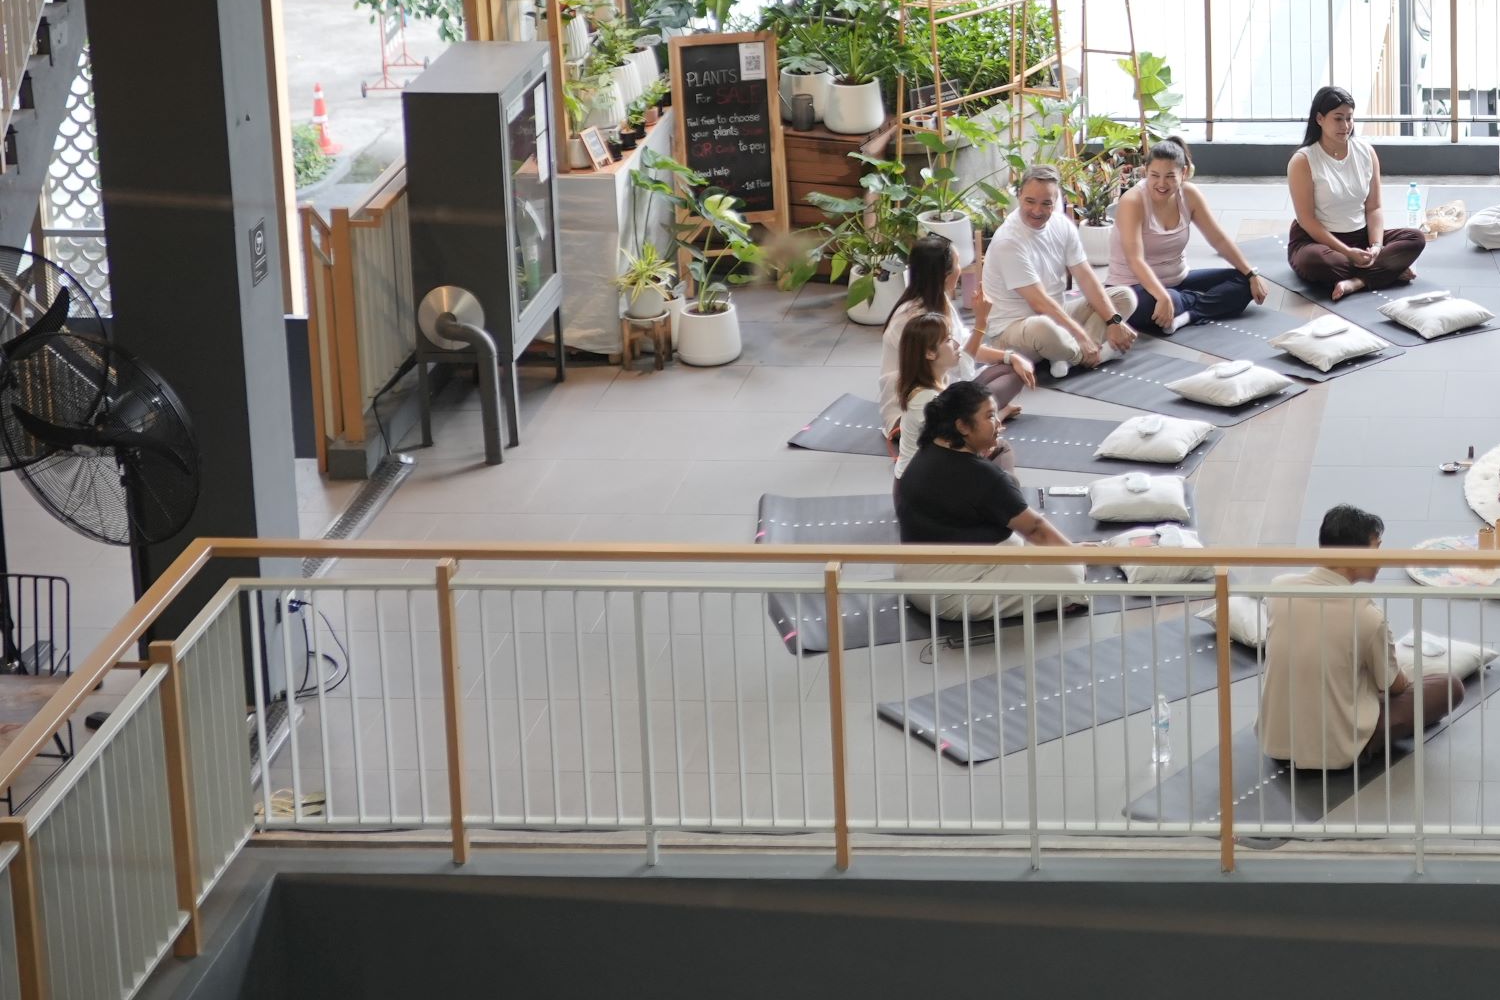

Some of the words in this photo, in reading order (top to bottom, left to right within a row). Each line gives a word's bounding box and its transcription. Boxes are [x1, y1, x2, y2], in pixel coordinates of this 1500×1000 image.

[686, 69, 738, 87] PLANTS
[695, 93, 711, 104] For
[701, 115, 716, 126] free
[717, 114, 726, 123] to
[728, 113, 760, 123] choose
[691, 130, 710, 141] your
[713, 125, 739, 139] plants
[738, 140, 747, 151] to
[749, 142, 766, 154] pay
[713, 166, 731, 177] help
